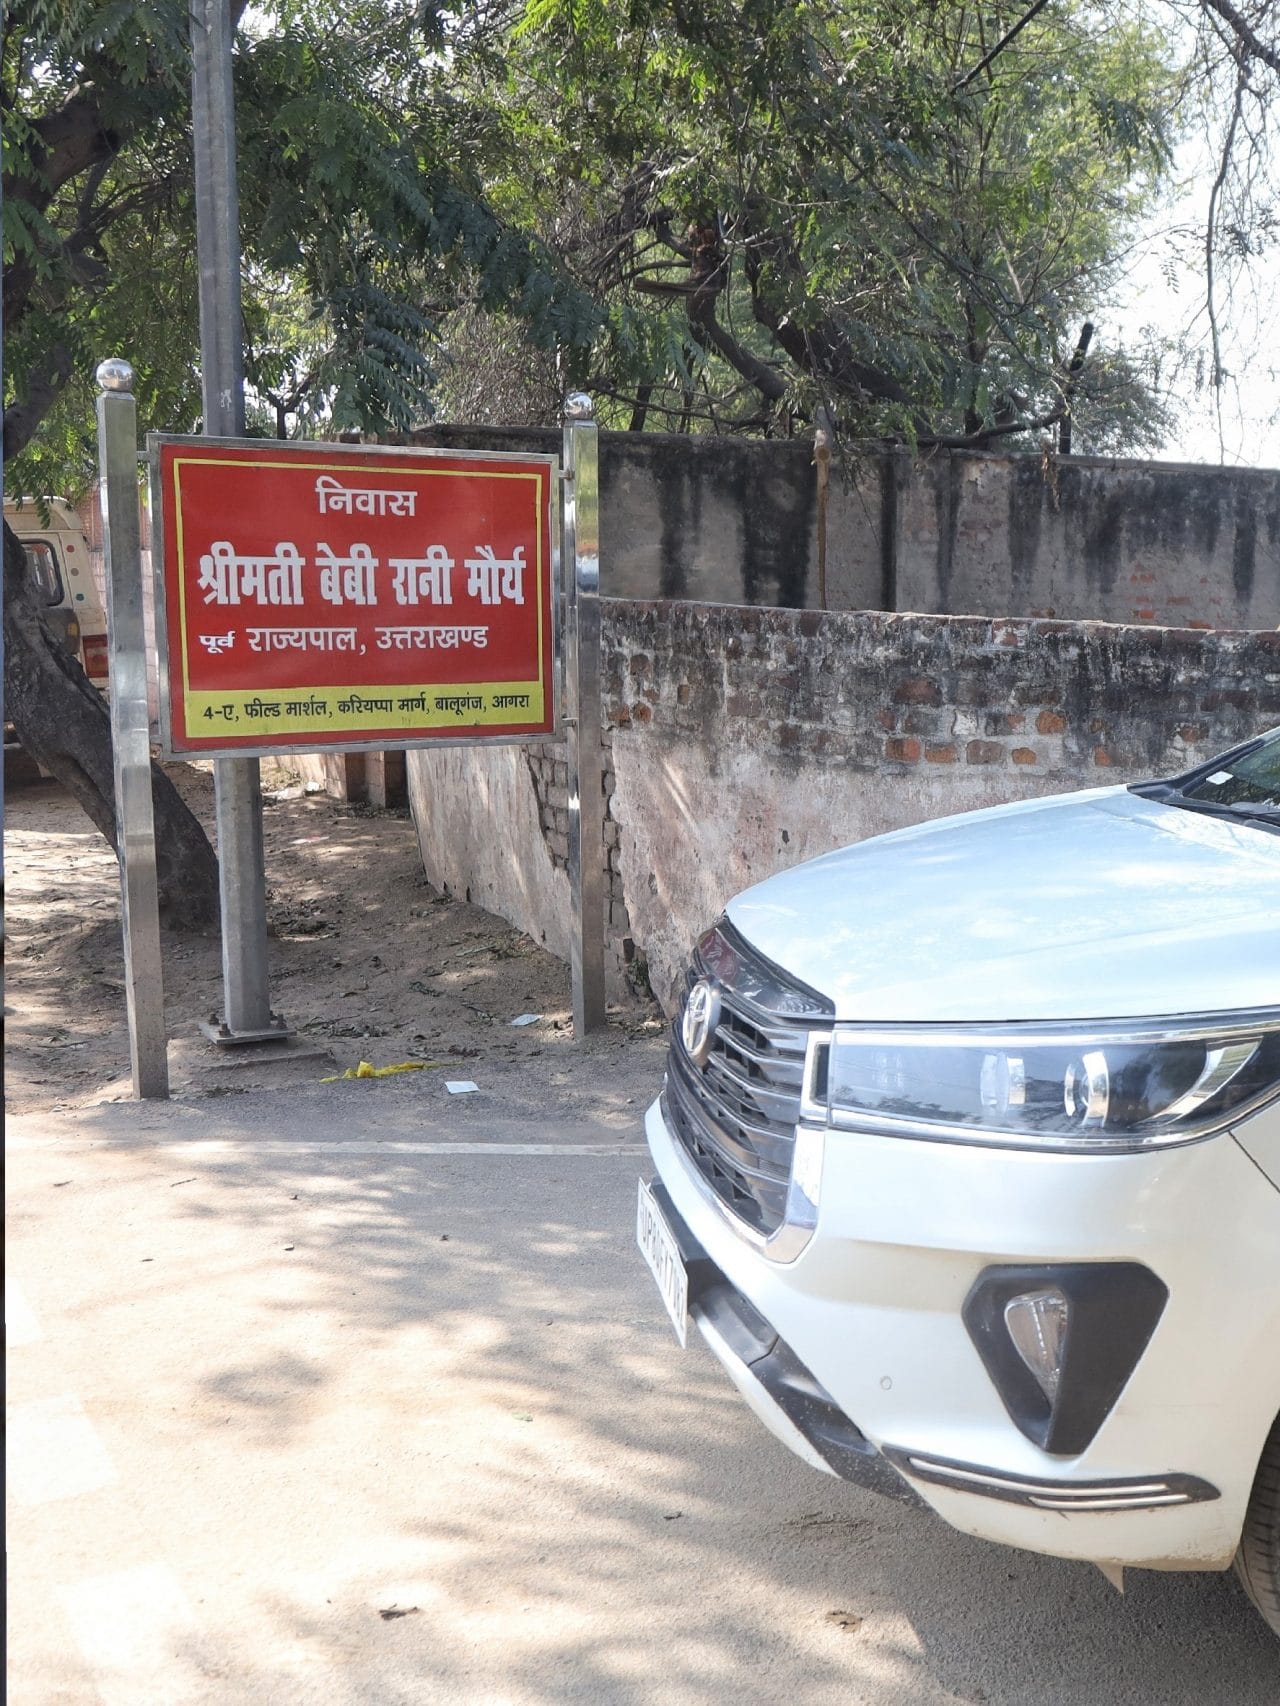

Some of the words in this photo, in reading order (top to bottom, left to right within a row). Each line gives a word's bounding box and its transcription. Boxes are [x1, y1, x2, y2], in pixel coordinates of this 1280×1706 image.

[315, 475, 418, 516] निवास
[197, 541, 306, 605] श्रीमती
[315, 542, 379, 605] बेबी
[388, 544, 455, 605] रानी
[464, 545, 527, 605] मौर्य
[199, 630, 236, 654] पूर्व
[246, 627, 367, 656] राज्यपाल,
[375, 625, 489, 649] उत्तराखण्ड
[244, 698, 281, 718] फील्ड
[285, 694, 333, 719] मार्शल,
[337, 694, 393, 714] करियप्पा
[397, 691, 431, 715] मार्ग,
[434, 691, 487, 716] बालूगंज,
[492, 694, 530, 709] आगरा
